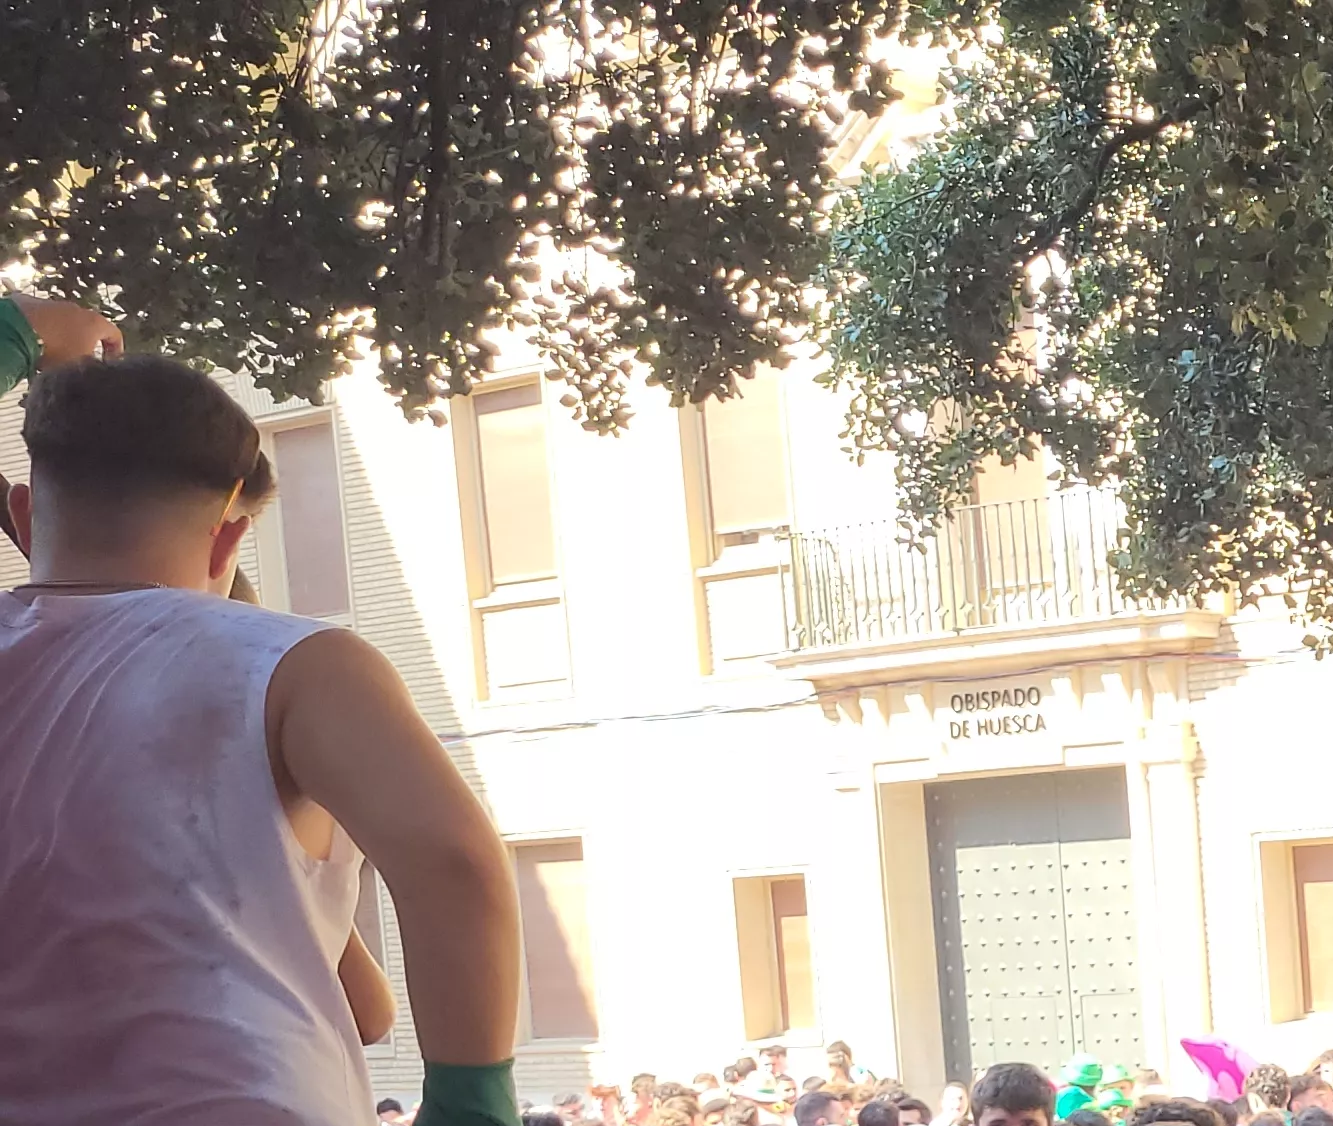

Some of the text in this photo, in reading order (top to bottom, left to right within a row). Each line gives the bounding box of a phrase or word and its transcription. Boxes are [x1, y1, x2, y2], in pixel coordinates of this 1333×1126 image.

[950, 686, 1041, 714] OBISPADO
[949, 713, 1047, 740] DE HUESCA
